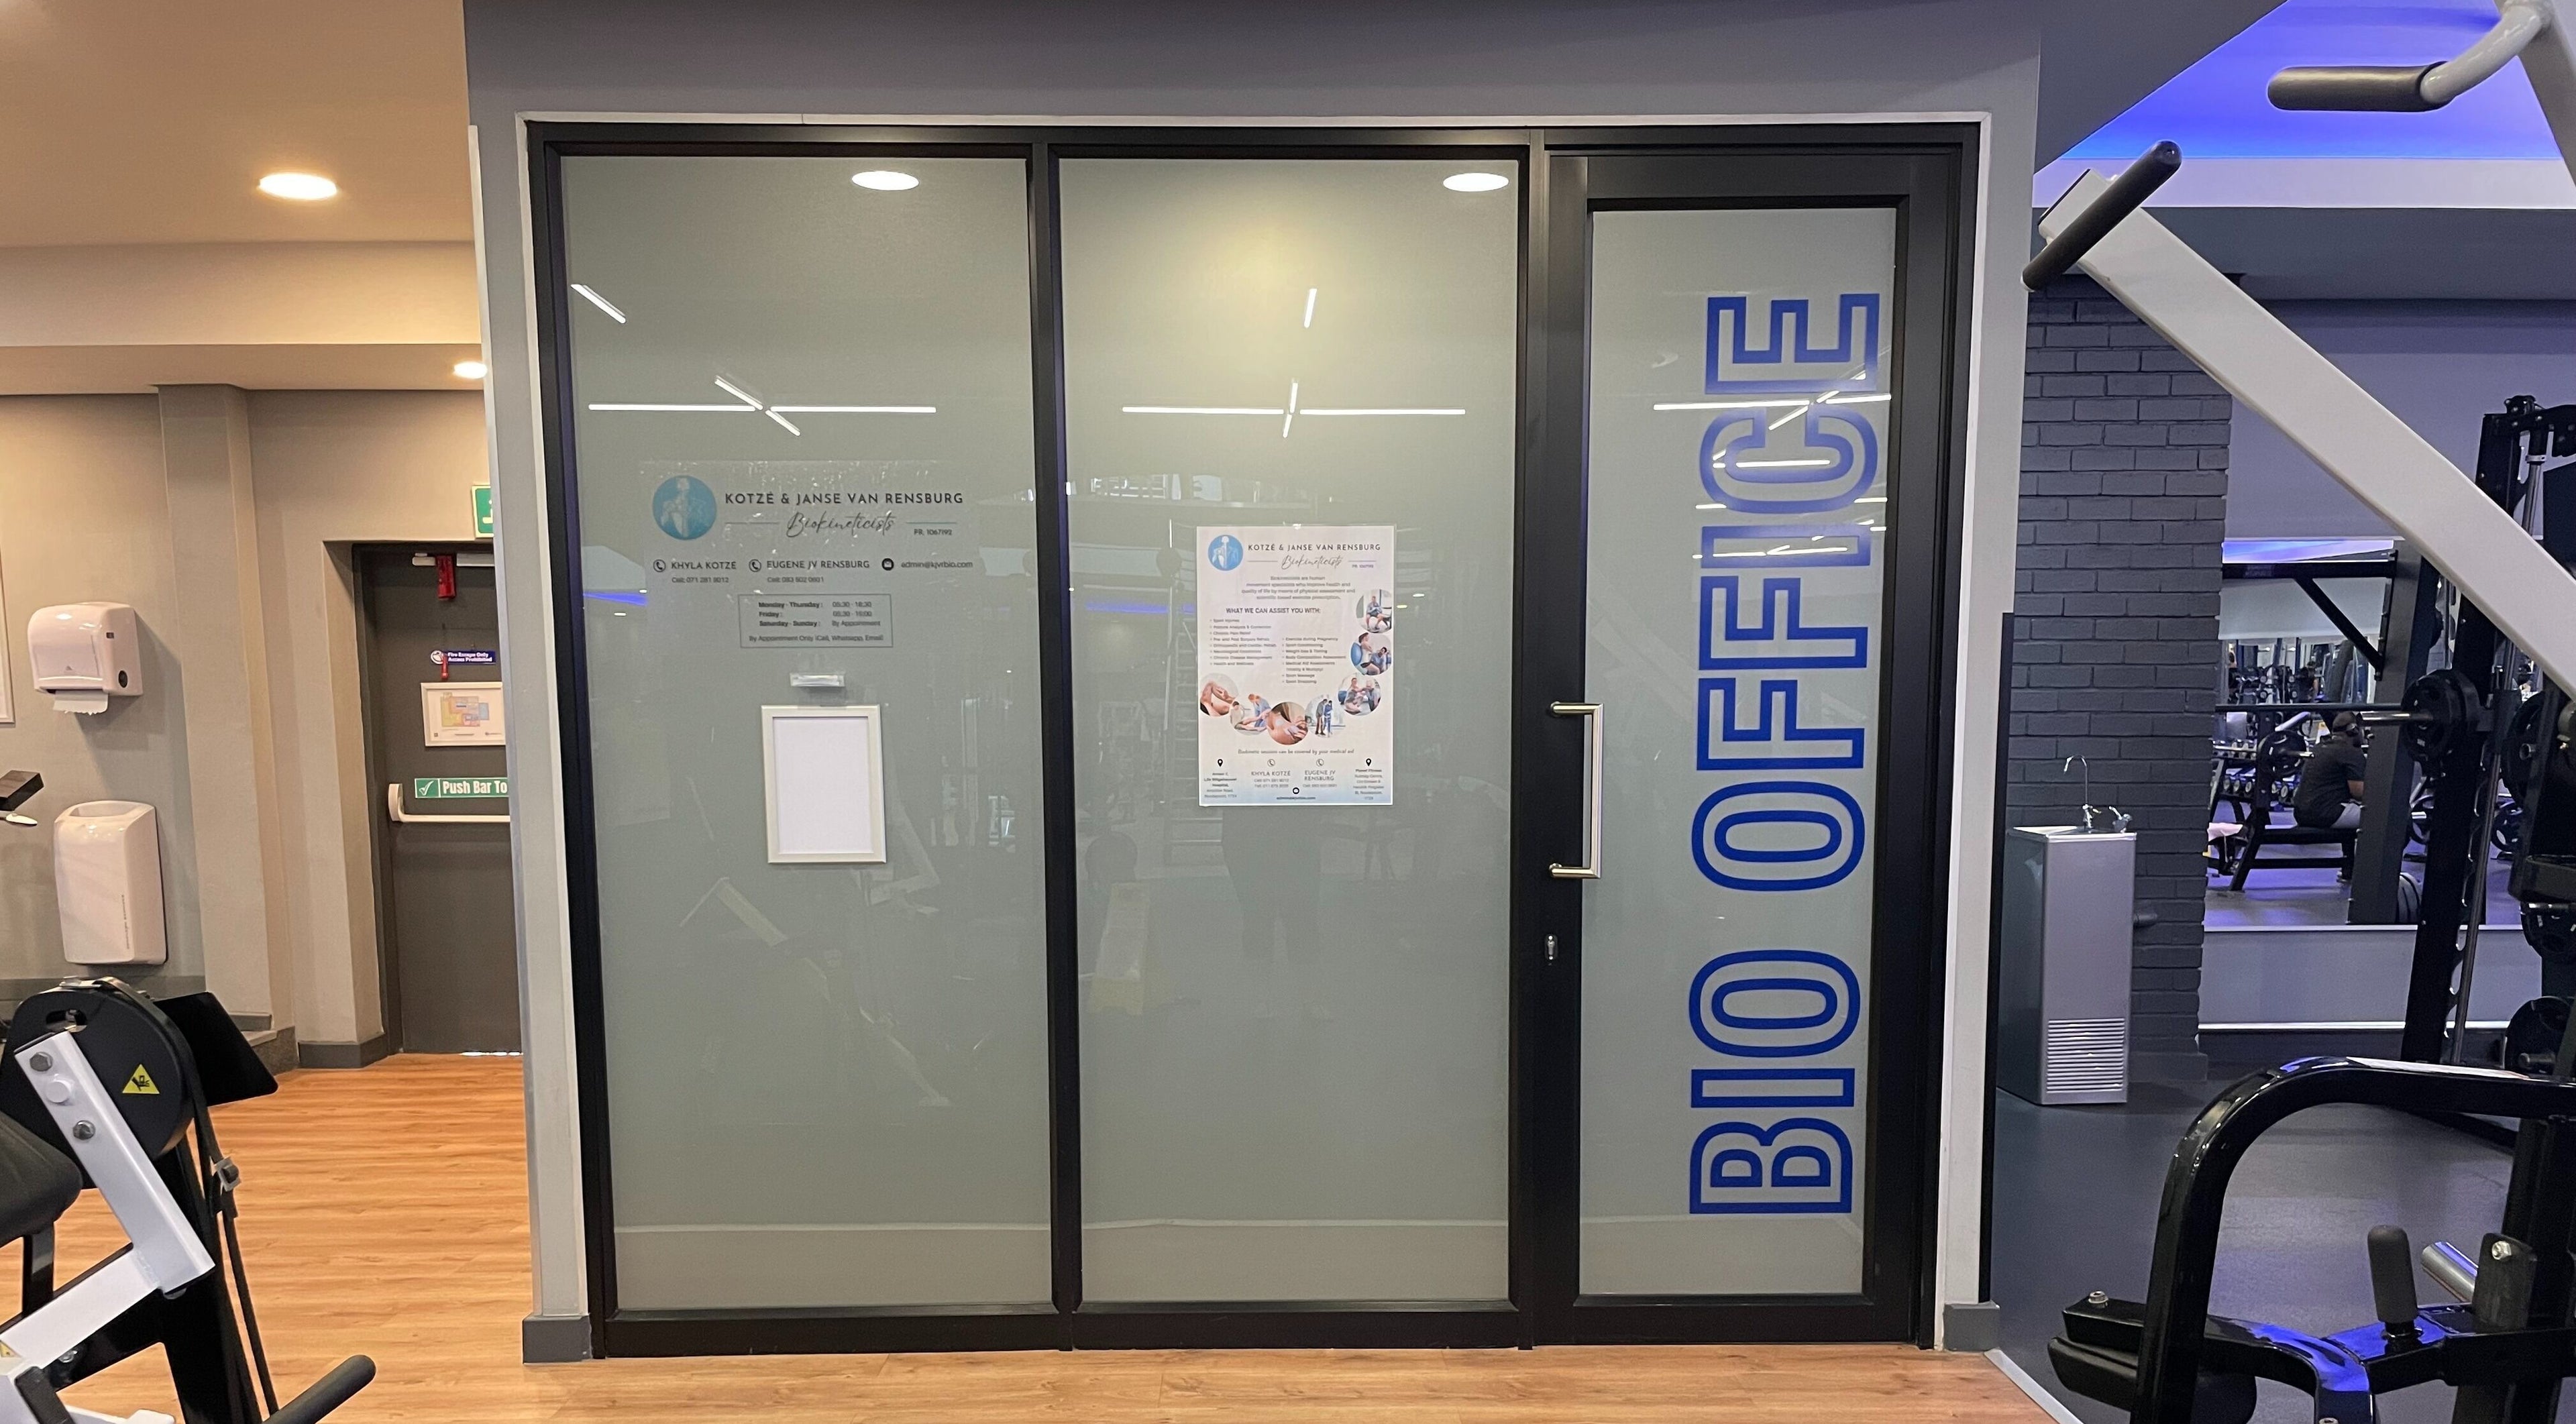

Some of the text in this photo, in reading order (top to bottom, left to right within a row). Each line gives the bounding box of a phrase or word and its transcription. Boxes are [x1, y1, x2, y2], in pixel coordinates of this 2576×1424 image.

[725, 491, 963, 505] KOTZÉ & JANSE VAN RENSBURG
[786, 510, 896, 537] Biokineticists
[1248, 543, 1275, 551] KOTZÉ
[672, 561, 702, 569] KHYLA
[767, 560, 869, 570] EUGENE JV RENSBURG
[1281, 554, 1343, 569] Biokineticists
[1689, 292, 1880, 1214] BIO OFFICE
[443, 781, 508, 794] Push Bar To
